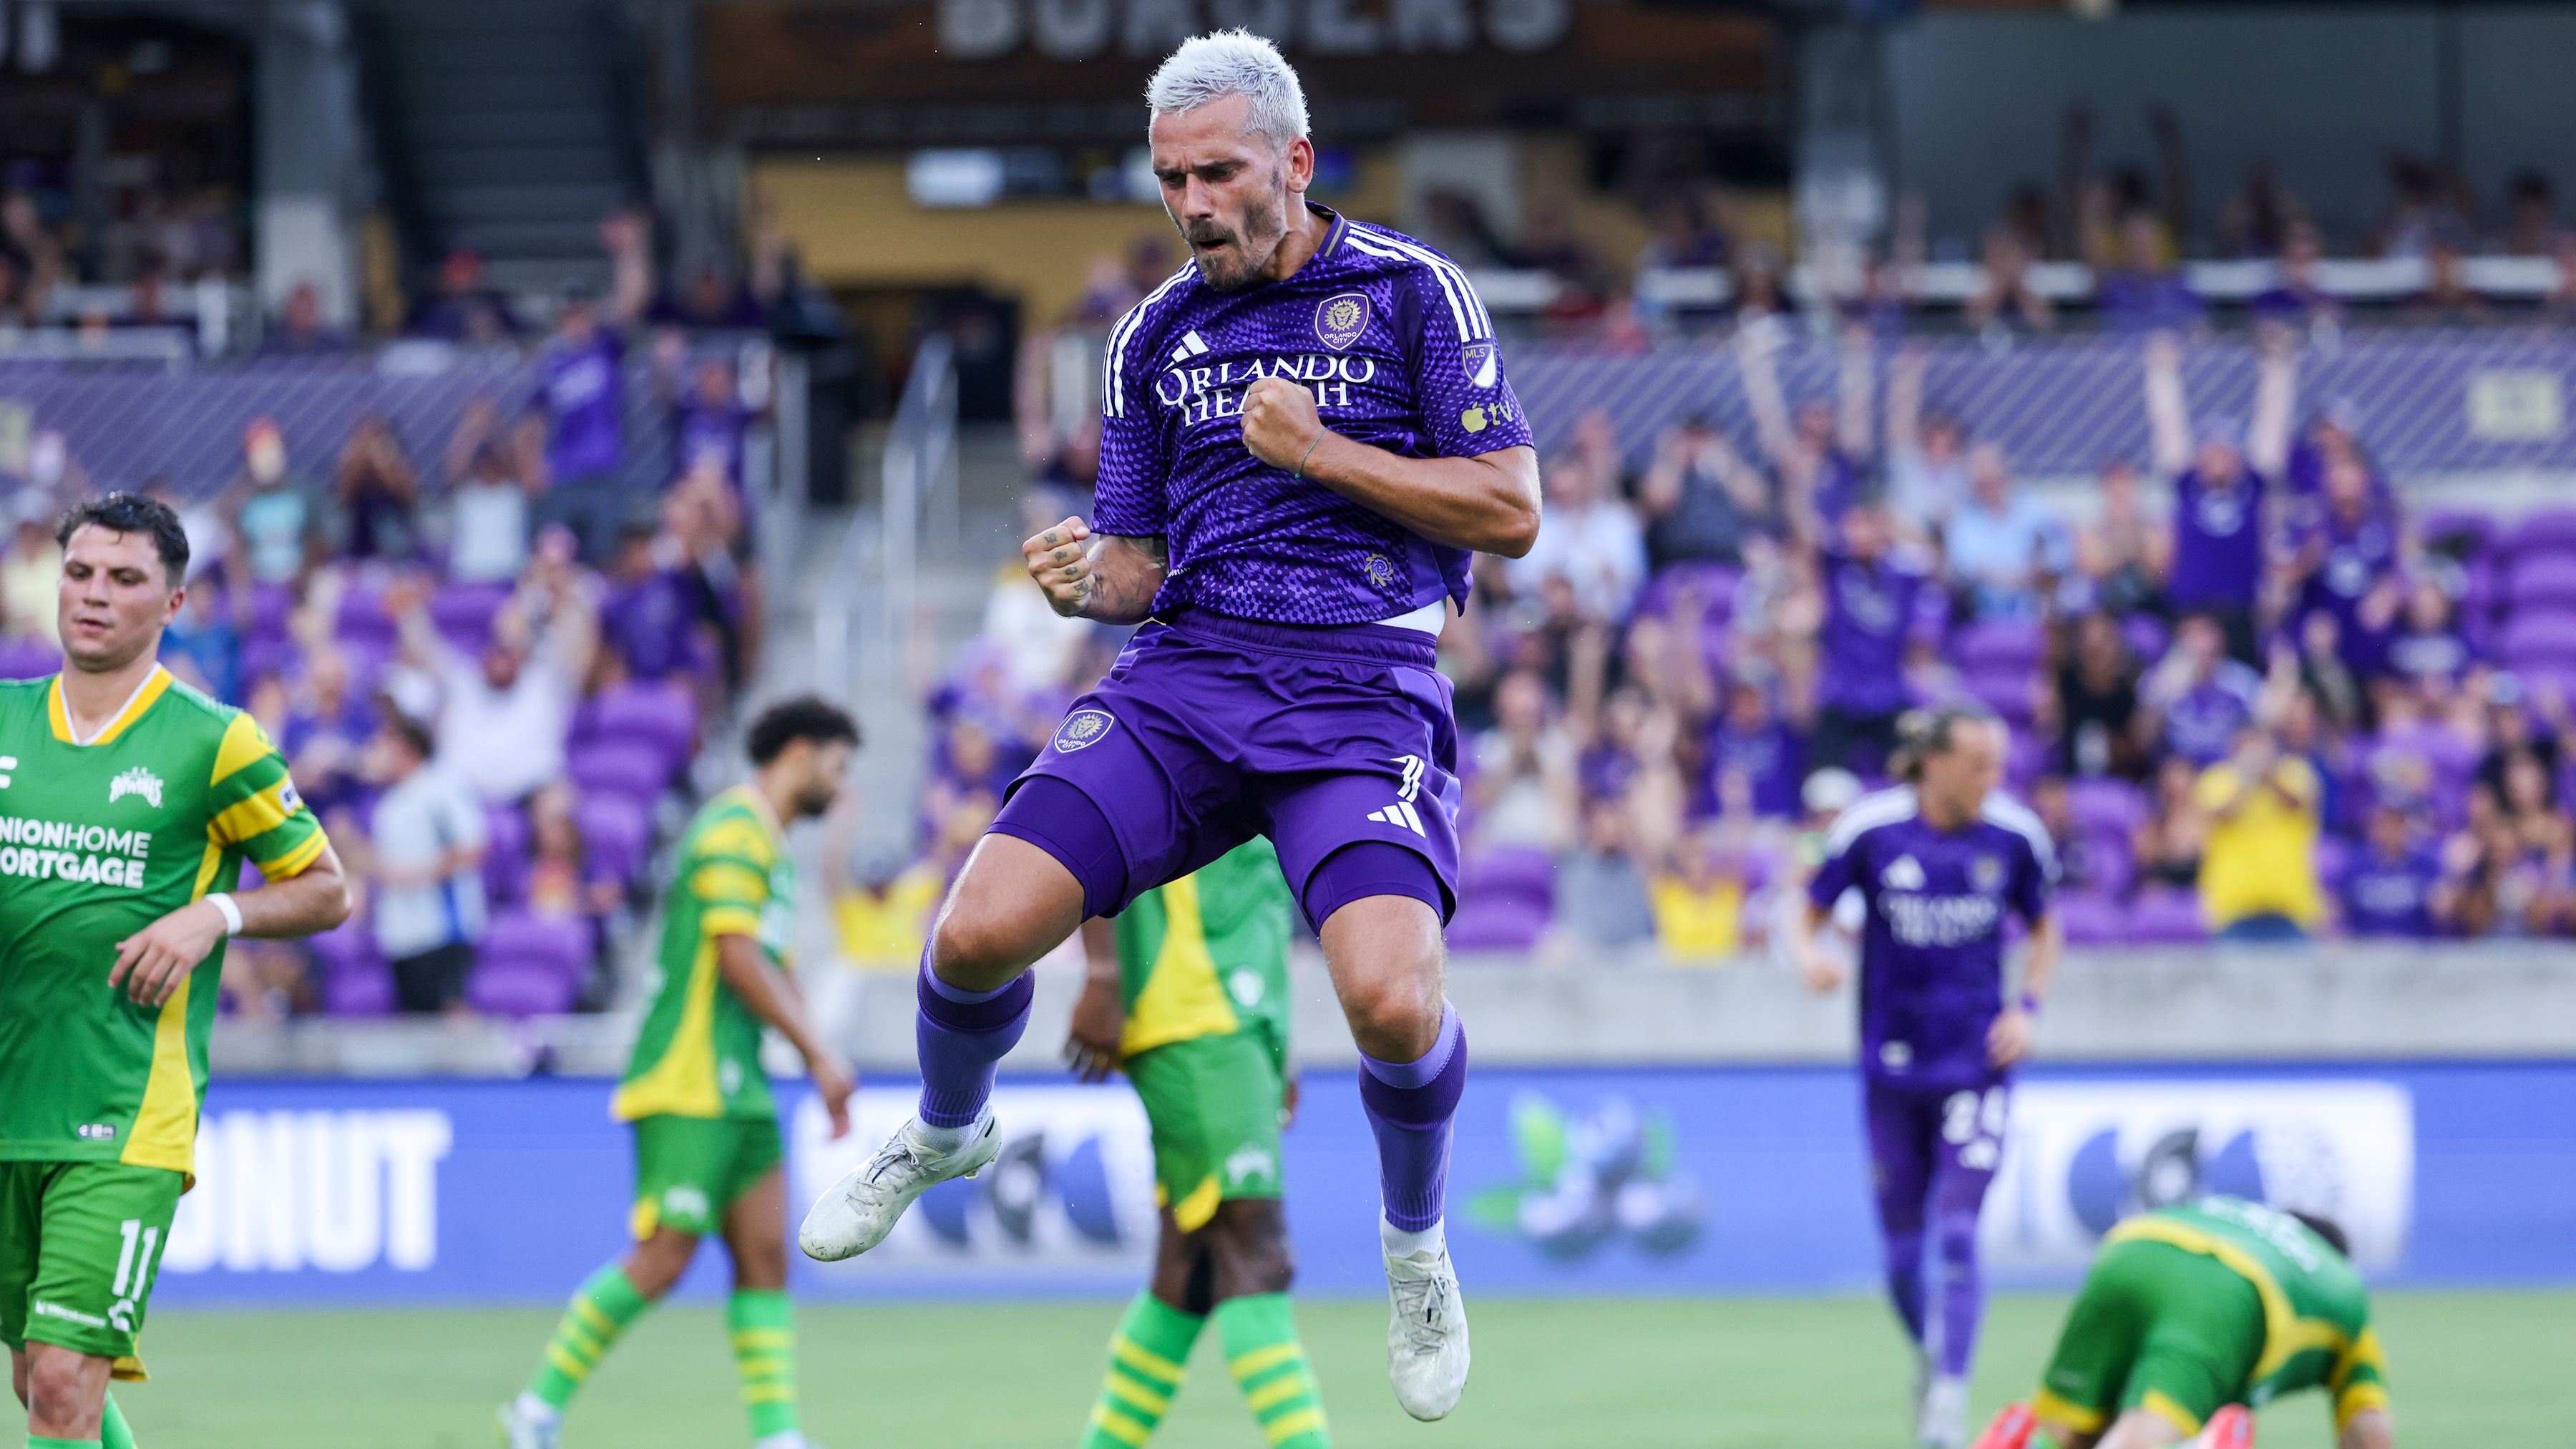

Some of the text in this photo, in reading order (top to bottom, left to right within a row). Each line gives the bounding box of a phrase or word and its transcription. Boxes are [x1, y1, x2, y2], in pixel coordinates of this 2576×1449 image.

[1465, 348, 1485, 359] MLS
[1155, 353, 1375, 406] ORLANDO
[1488, 400, 1513, 426] tv
[112, 1219, 158, 1302] 11
